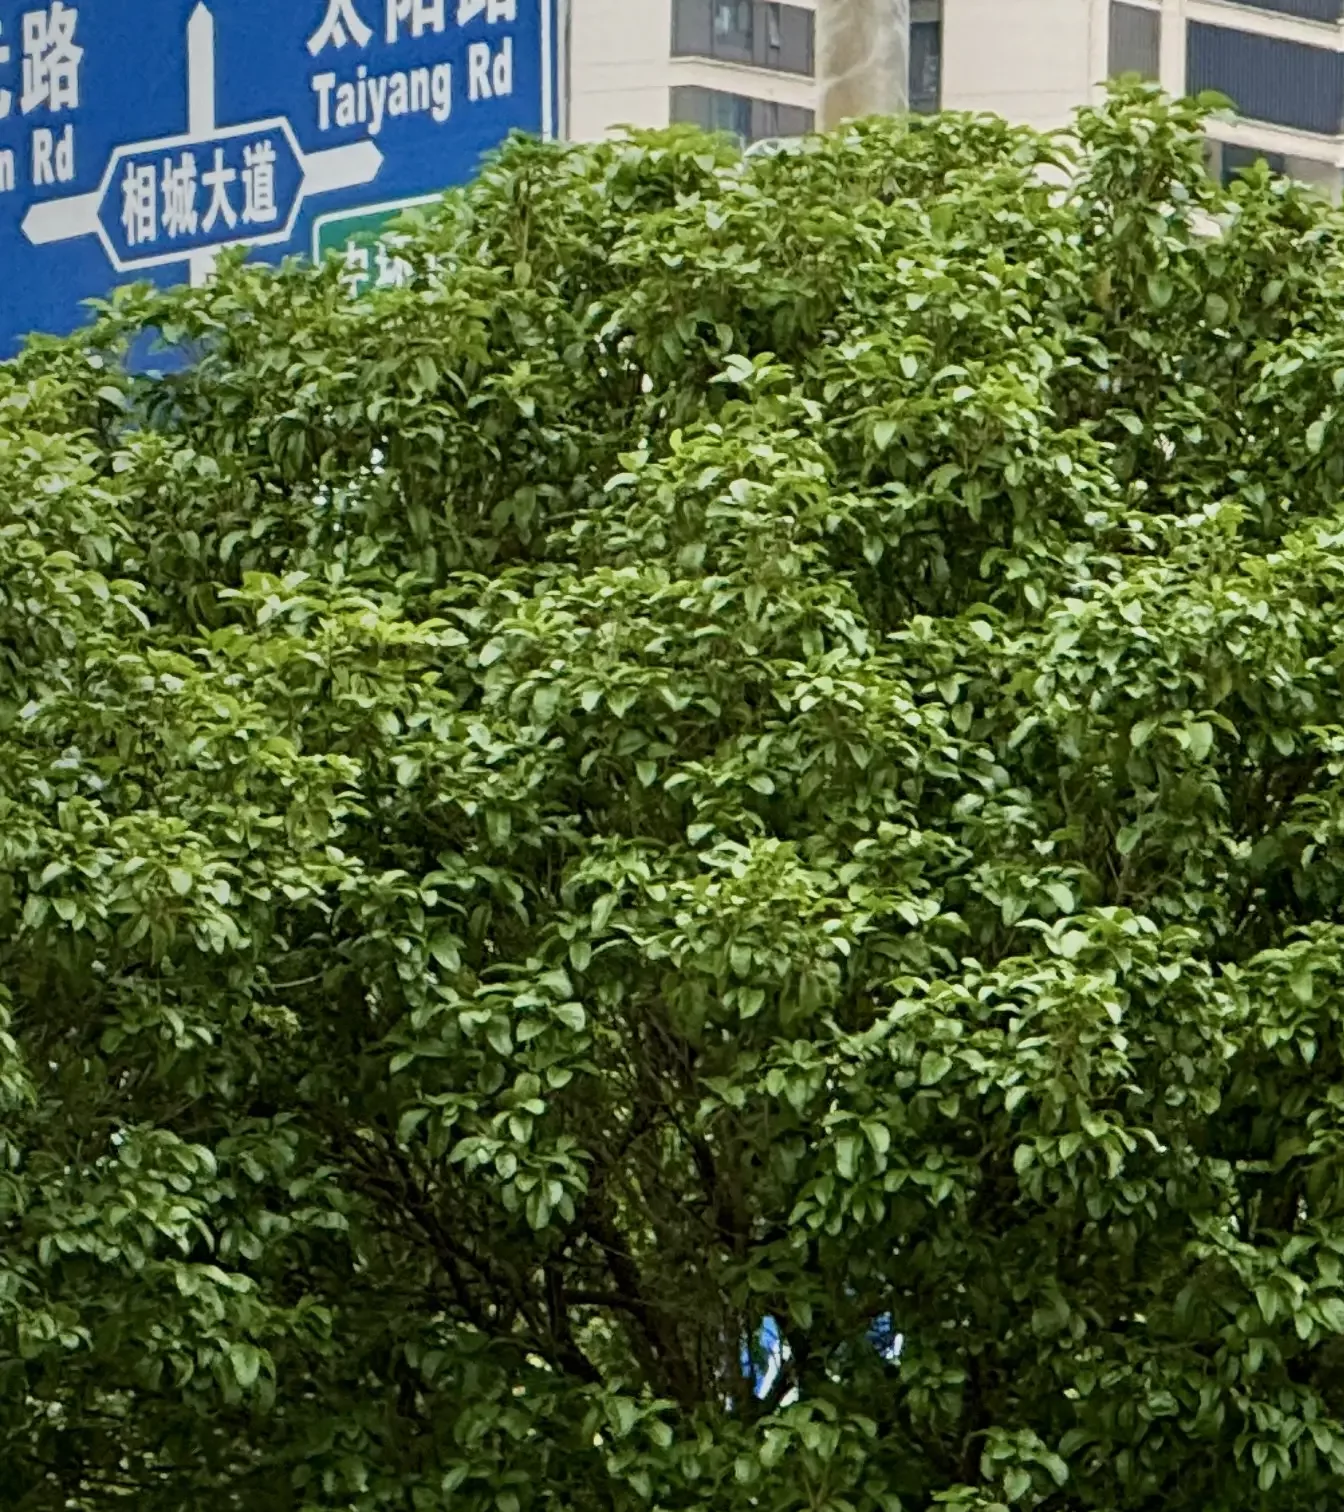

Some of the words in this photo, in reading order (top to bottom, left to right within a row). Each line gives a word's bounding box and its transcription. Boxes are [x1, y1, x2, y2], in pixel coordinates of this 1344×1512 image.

[0, 1, 84, 117] 路
[312, 62, 452, 135] Taiyang
[468, 36, 513, 101] Rd
[33, 124, 74, 186] Rd
[121, 139, 278, 246] 相城大道
